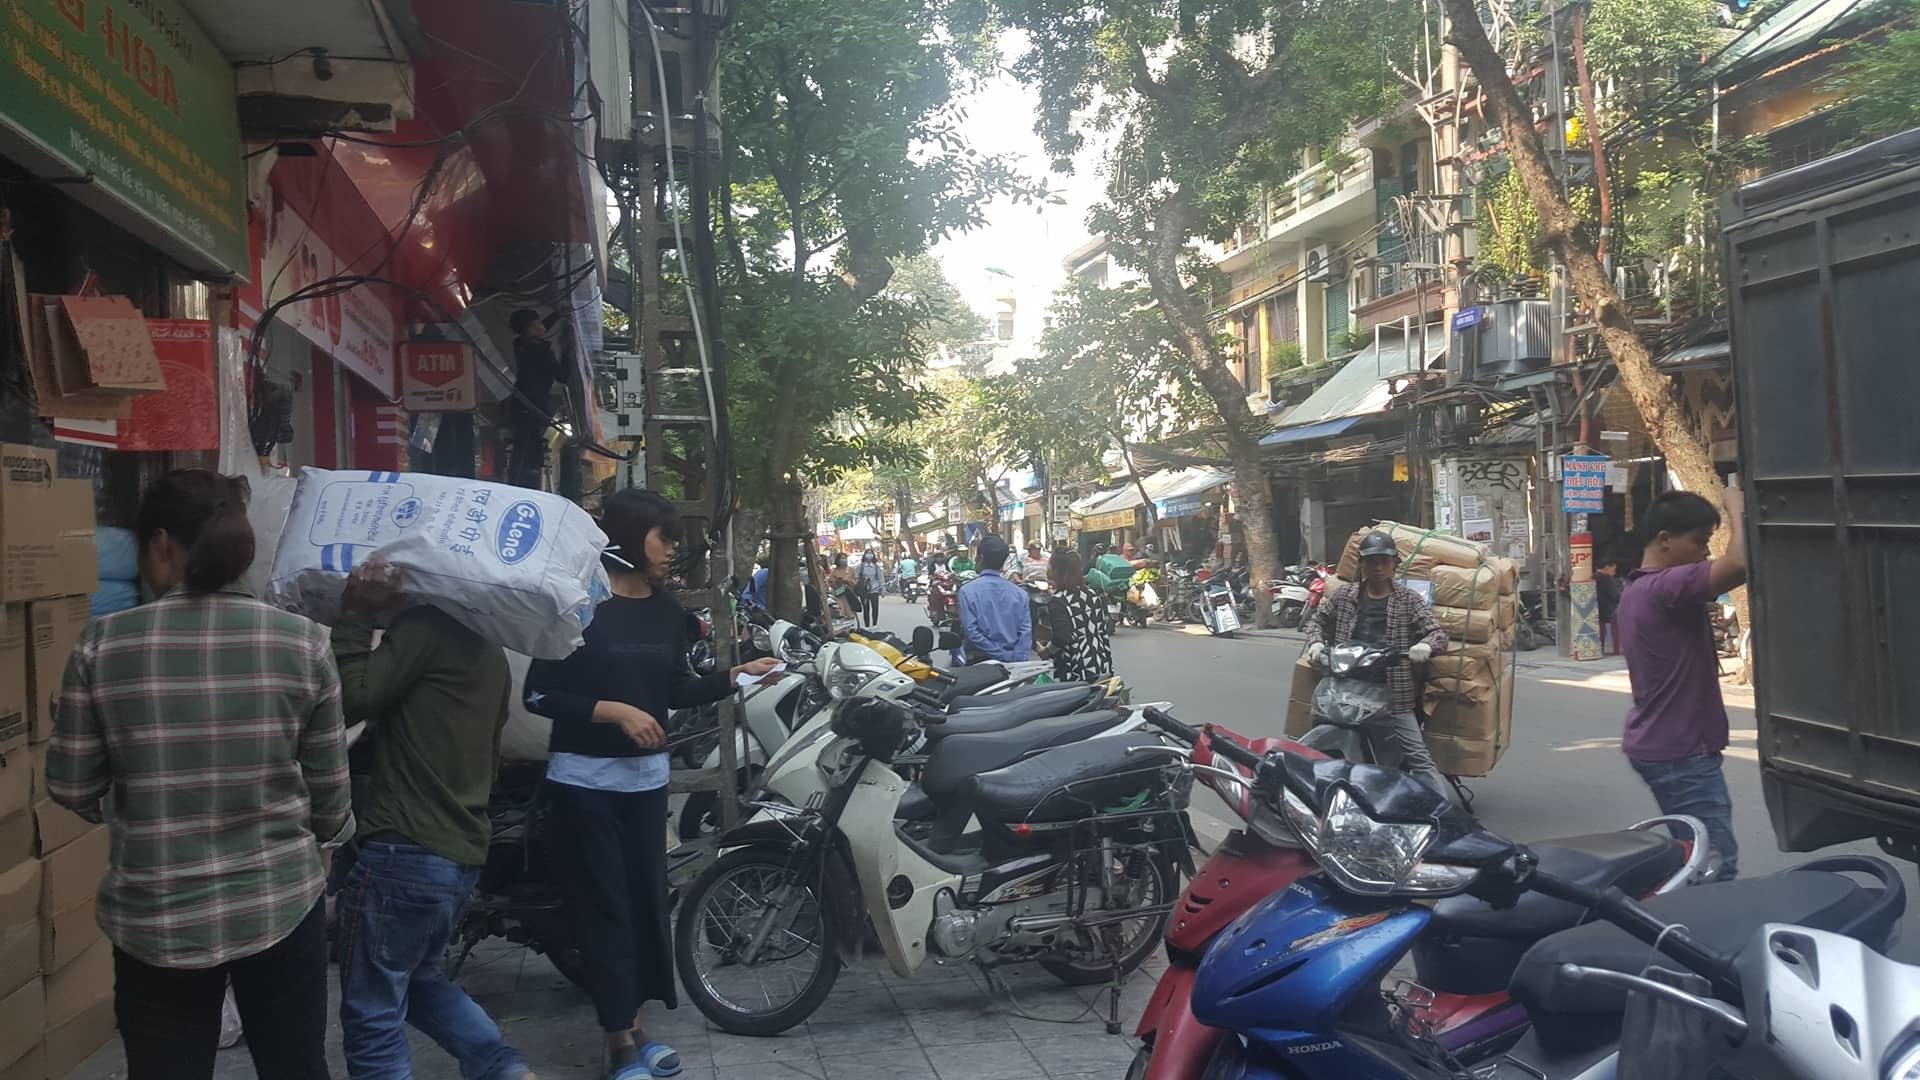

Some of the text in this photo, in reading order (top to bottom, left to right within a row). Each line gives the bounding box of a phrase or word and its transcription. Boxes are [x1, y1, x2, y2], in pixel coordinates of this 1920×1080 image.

[417, 355, 456, 372] ATM
[501, 504, 535, 558] G-Lene
[1287, 1040, 1344, 1055] HONDA
